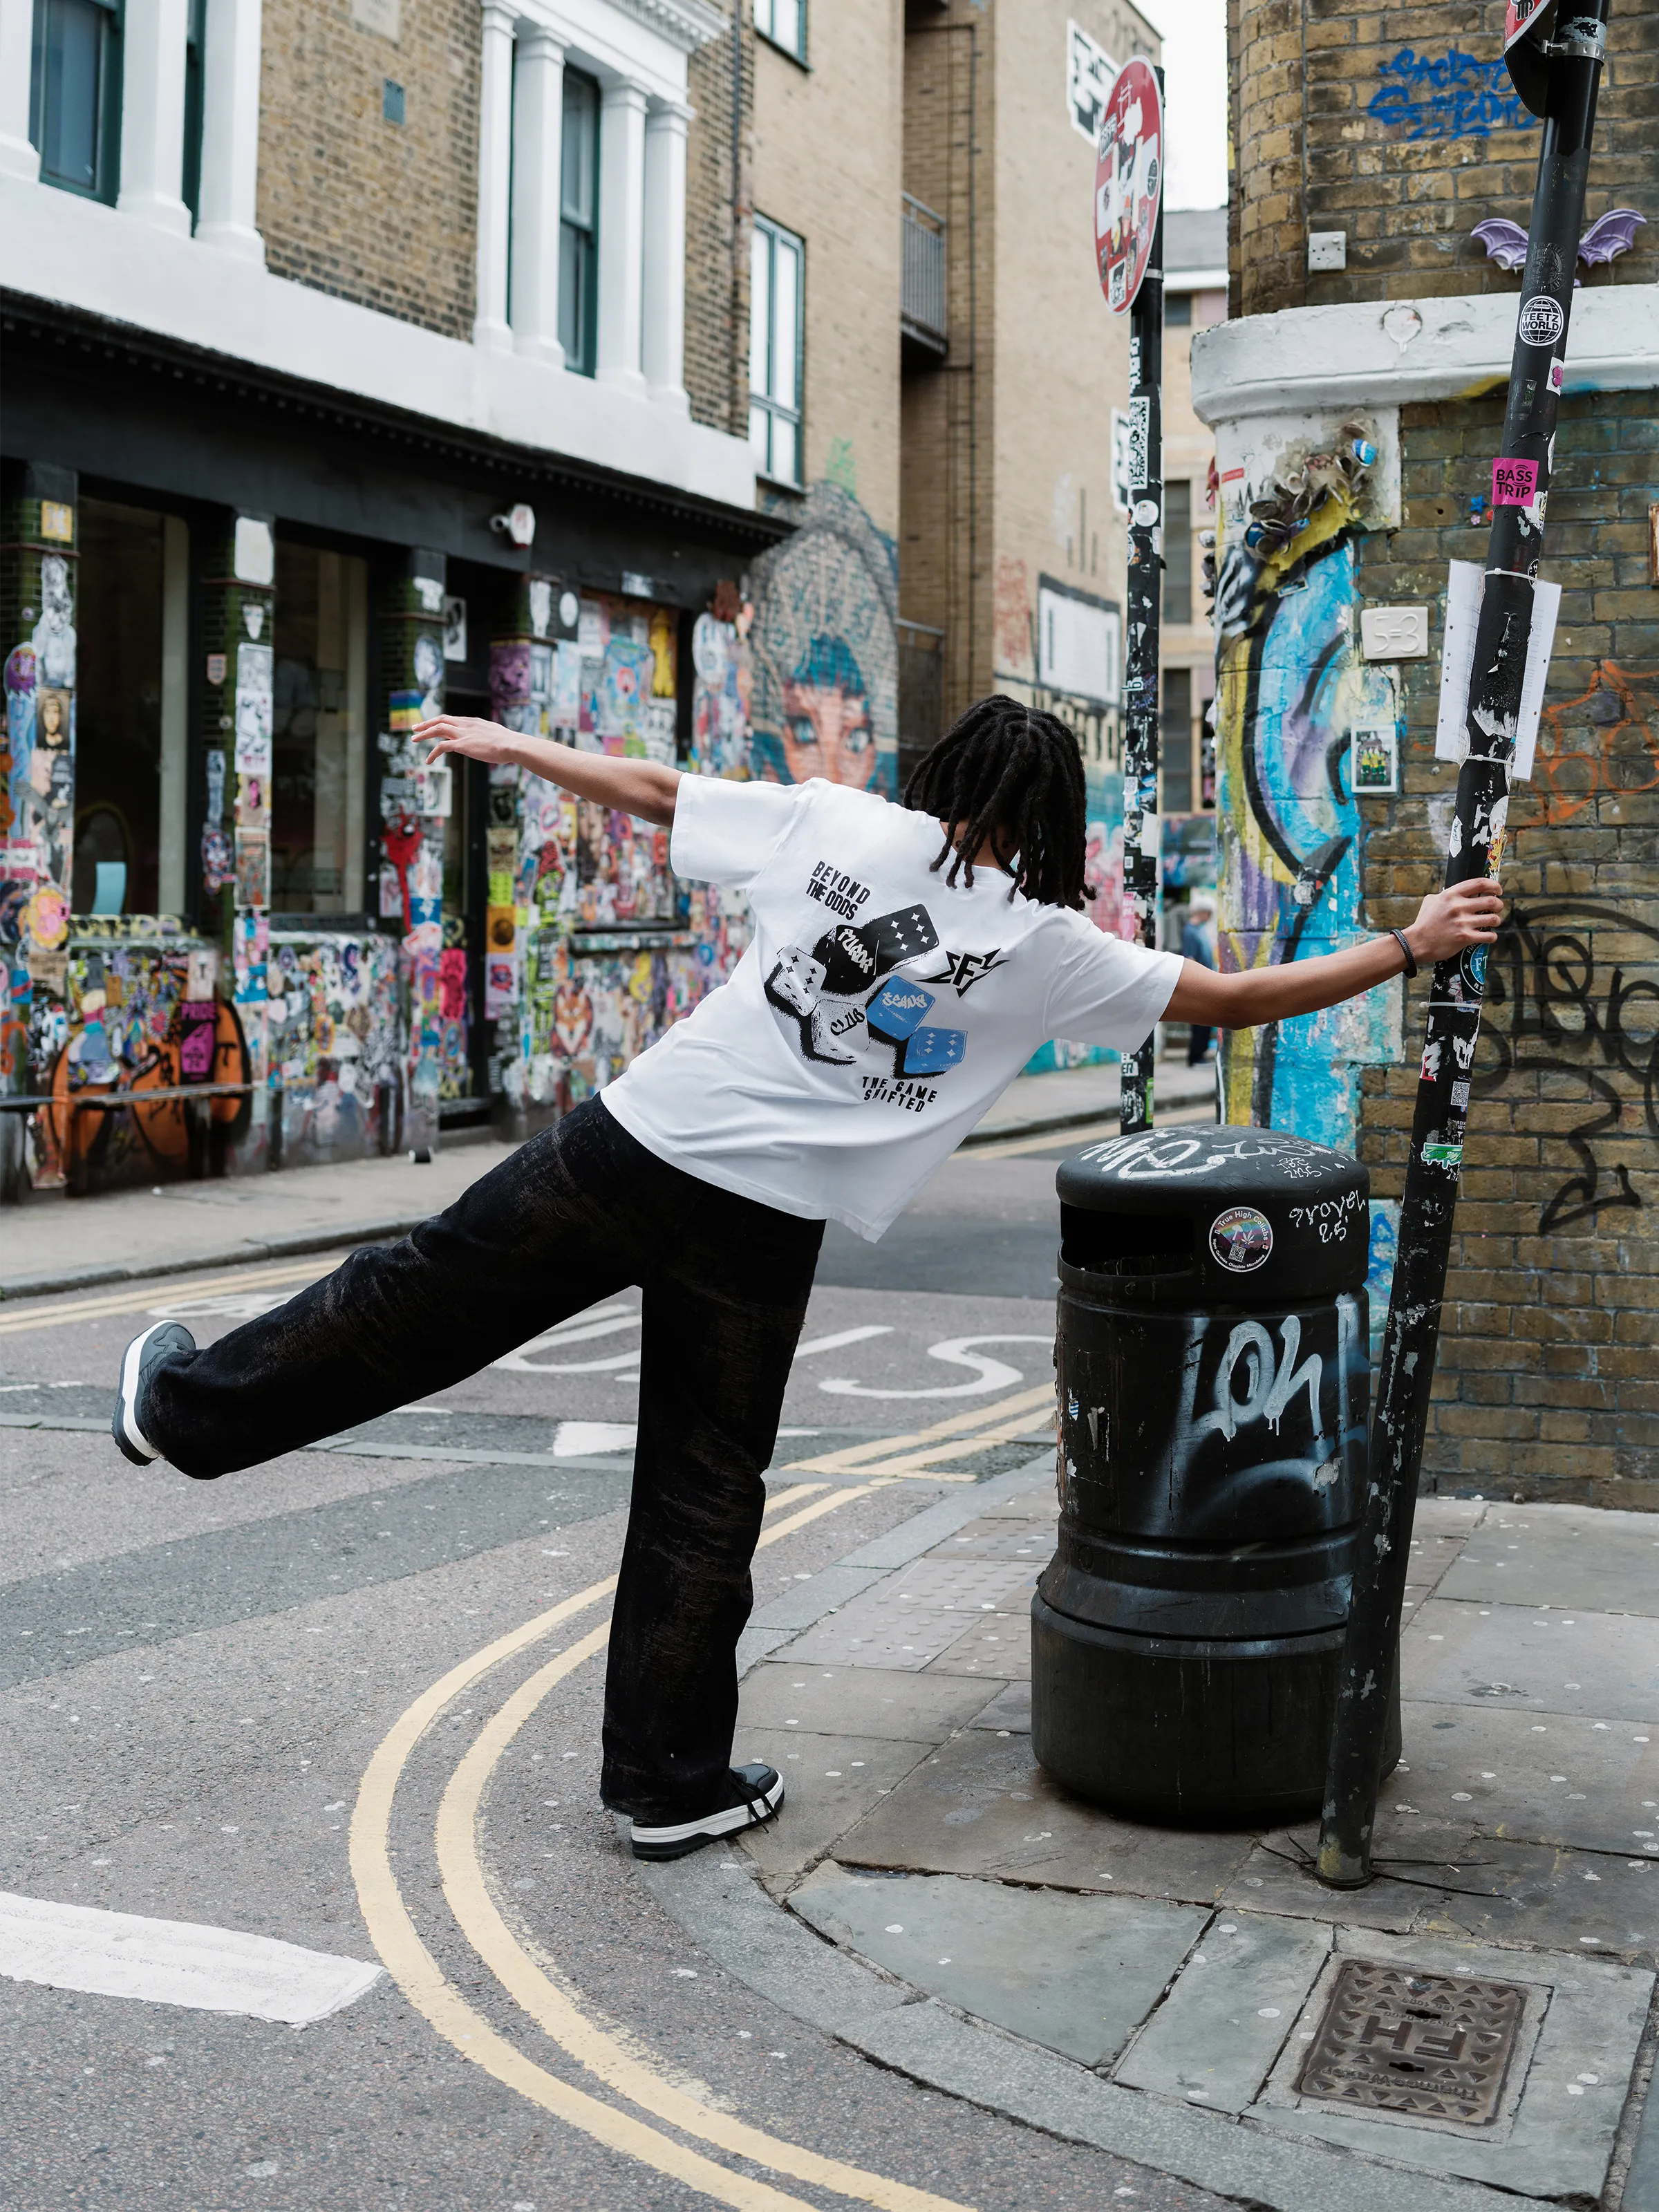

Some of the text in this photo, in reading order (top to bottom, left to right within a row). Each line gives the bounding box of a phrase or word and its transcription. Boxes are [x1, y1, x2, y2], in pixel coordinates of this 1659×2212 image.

[1522, 321, 1559, 331] WORLD
[1524, 312, 1559, 323] TEETZ
[1496, 469, 1533, 483] BASS
[1496, 482, 1531, 498] TRIP
[812, 860, 871, 905] BEYOND
[805, 878, 859, 921] THE ODDS
[830, 1008, 865, 1036] CLUB
[862, 1076, 938, 1103] THE GAME
[863, 1089, 926, 1114] SHIFTED
[1217, 1210, 1269, 1241] True High Collabs
[1358, 2014, 1468, 2061] FH
